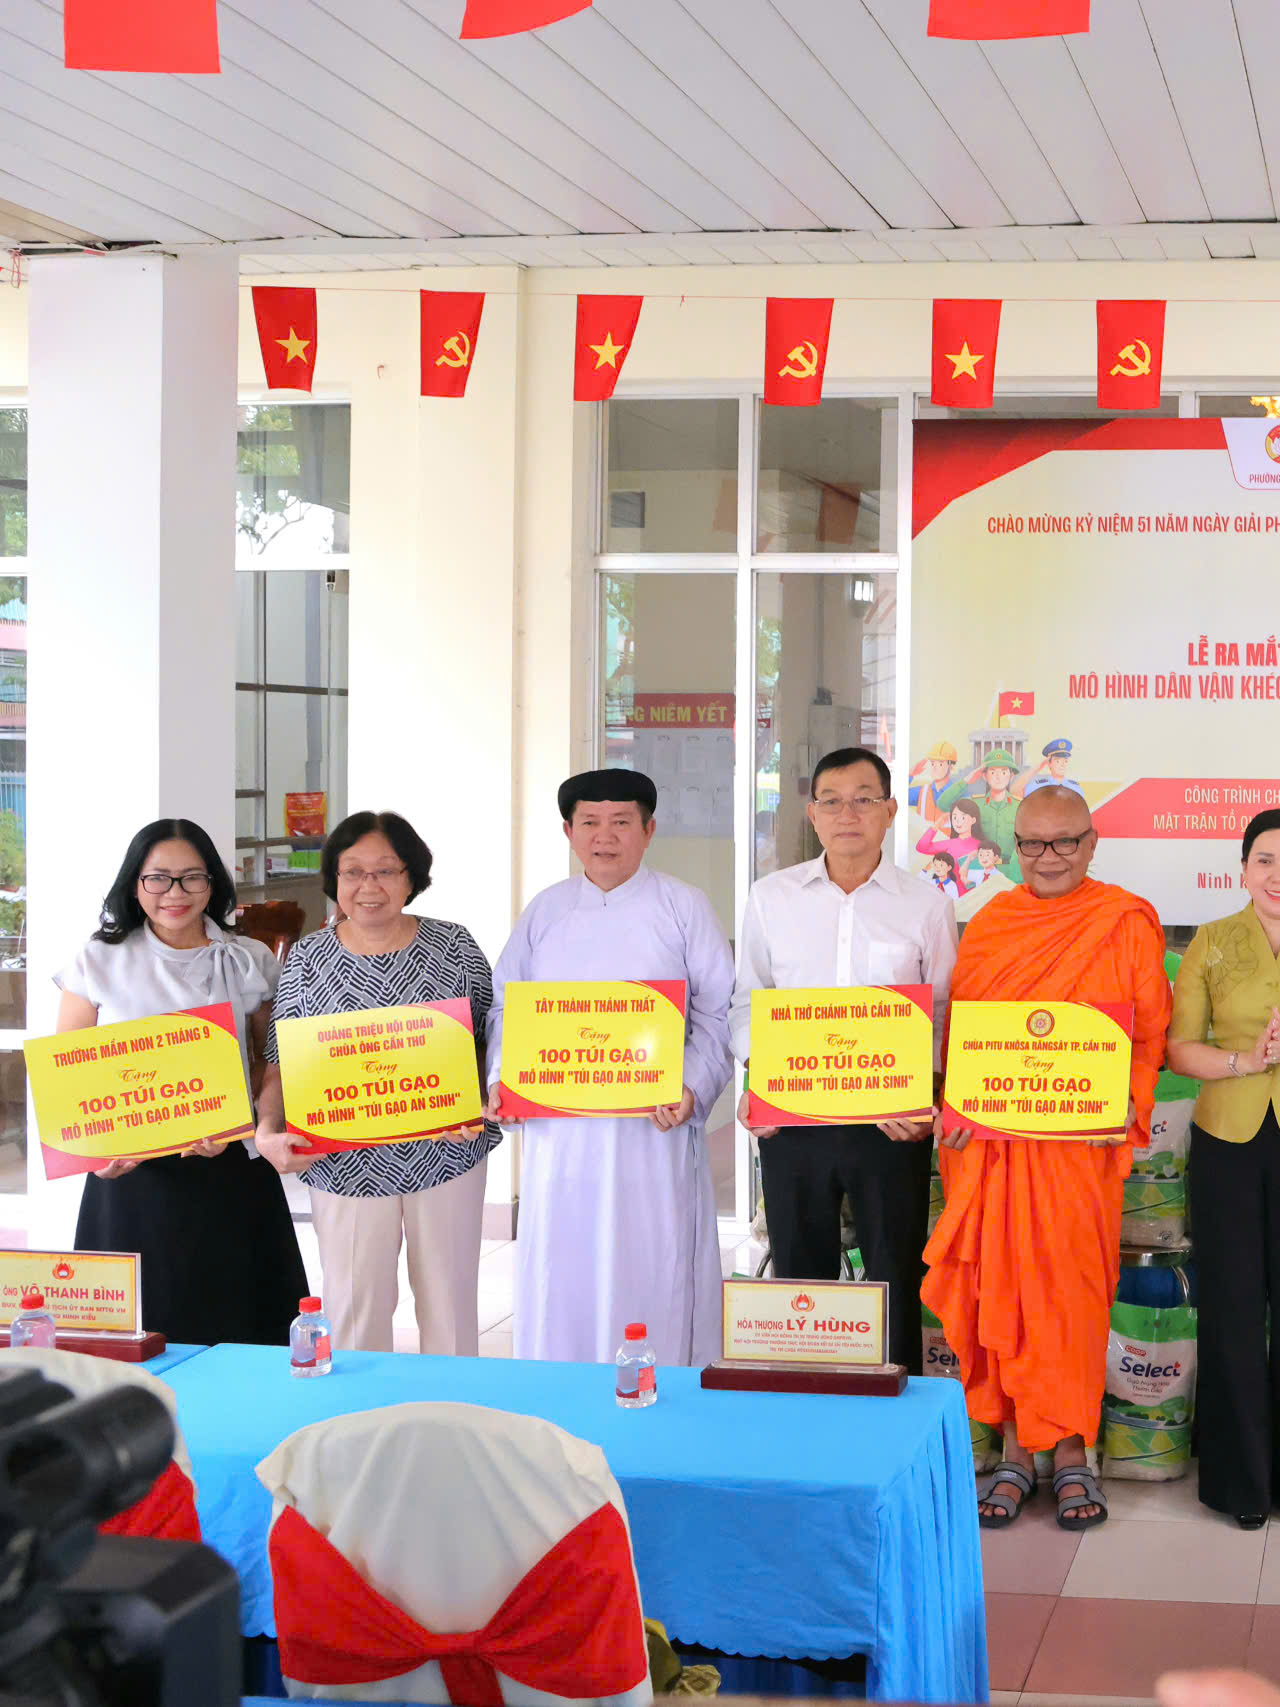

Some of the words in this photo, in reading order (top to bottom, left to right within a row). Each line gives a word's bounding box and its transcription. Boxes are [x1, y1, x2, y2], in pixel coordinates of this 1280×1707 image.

[1250, 473, 1280, 484] PHƯỜNG
[988, 513, 1024, 534] CHÀO
[1028, 512, 1071, 533] MỪNG
[1076, 512, 1093, 533] KỶ
[1098, 513, 1133, 536] NIỆM
[1138, 516, 1151, 532] 51
[1156, 513, 1188, 532] NĂM
[1192, 513, 1230, 532] NGÀY
[1234, 513, 1261, 532] GIẢI
[1188, 635, 1208, 666] LỄ
[1215, 643, 1239, 666] RA
[1069, 672, 1098, 699] MÔ
[1105, 672, 1148, 699] HÌNH
[1155, 672, 1191, 699] DÂN
[1199, 672, 1233, 702] VẬN
[650, 704, 690, 722] NIÊM
[697, 701, 728, 722] YẾT
[1184, 785, 1219, 804] CÔNG
[1223, 785, 1260, 804] TRÌNH
[1153, 813, 1179, 832] MẶT
[1184, 813, 1217, 832] TRẬN
[1223, 809, 1236, 830] TỔ
[1198, 872, 1232, 889] Ninh
[536, 998, 554, 1013] TÂY
[557, 997, 590, 1013] THÀNH
[595, 997, 627, 1012] THÁNH
[631, 995, 655, 1012] THẤT
[771, 1005, 791, 1021] NHÀ
[794, 1006, 812, 1020] THỜ
[815, 1003, 847, 1020] CHÁNH
[850, 1002, 868, 1018] TOÀ
[871, 1001, 890, 1017] CẦN
[894, 1003, 911, 1016] THƠ
[356, 1024, 383, 1038] TRIỆU
[386, 1020, 403, 1033] HỘI
[53, 1046, 98, 1067] TRƯỜNG
[100, 1039, 128, 1058] MẦM
[131, 1037, 154, 1053] NON
[156, 1035, 164, 1048] 2
[165, 1027, 200, 1046] THÁNG
[203, 1026, 210, 1038] 9
[329, 1042, 356, 1057] CHÙA
[359, 1040, 380, 1053] ÔNG
[383, 1036, 404, 1049] CẦN
[407, 1034, 426, 1047] THƠ
[963, 1039, 983, 1050] CHÙA
[985, 1041, 1002, 1050] PITU
[1004, 1039, 1029, 1051] KHÔSA
[1071, 1042, 1080, 1051] TP.
[1083, 1040, 1098, 1051] CẦN
[1102, 1041, 1116, 1052] THƠ
[786, 1056, 818, 1071] 100
[823, 1052, 852, 1069] TÚI
[857, 1054, 895, 1071] GẠO
[982, 1077, 1014, 1091] 100
[1018, 1074, 1047, 1092] TÚI
[1052, 1077, 1091, 1095] GẠO
[79, 1098, 116, 1114] 100
[120, 1086, 155, 1107] TÚI
[160, 1078, 204, 1099] GẠO
[3, 1285, 17, 1296] ÔNG
[44, 1286, 89, 1299] THANH
[94, 1286, 124, 1301] BÌNH
[737, 1317, 752, 1328] HÒA
[786, 1316, 805, 1330] LÝ
[814, 1317, 870, 1333] HÙNG
[1119, 1357, 1181, 1377] Select
